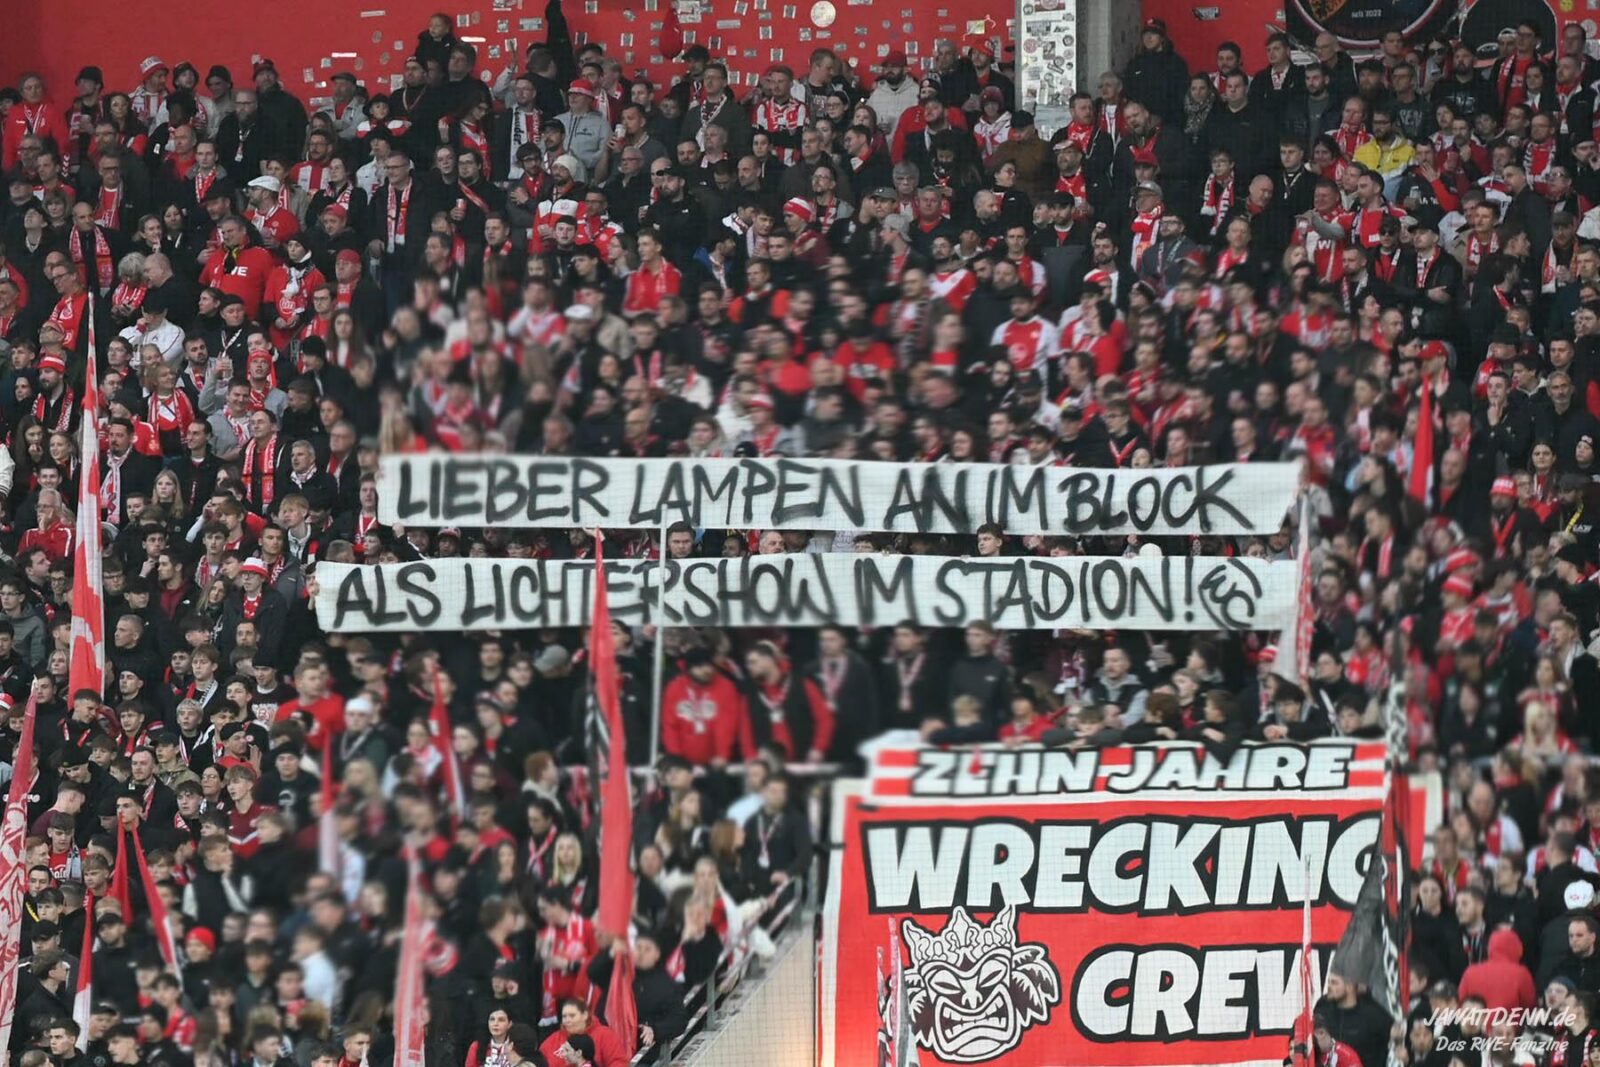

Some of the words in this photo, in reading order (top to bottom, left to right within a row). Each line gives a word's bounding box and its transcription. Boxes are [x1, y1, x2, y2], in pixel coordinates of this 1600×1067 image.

[400, 458, 610, 524] LIEBER
[629, 459, 865, 527] LAMPEN
[883, 466, 970, 532] AN
[985, 465, 1048, 531] IM
[1059, 466, 1253, 533] BLOCK
[333, 562, 442, 628] ALS
[461, 556, 838, 626] LICHTERSHOW
[854, 556, 919, 625] IM
[934, 556, 1194, 627] STADION!
[1106, 743, 1353, 794] JAHRE
